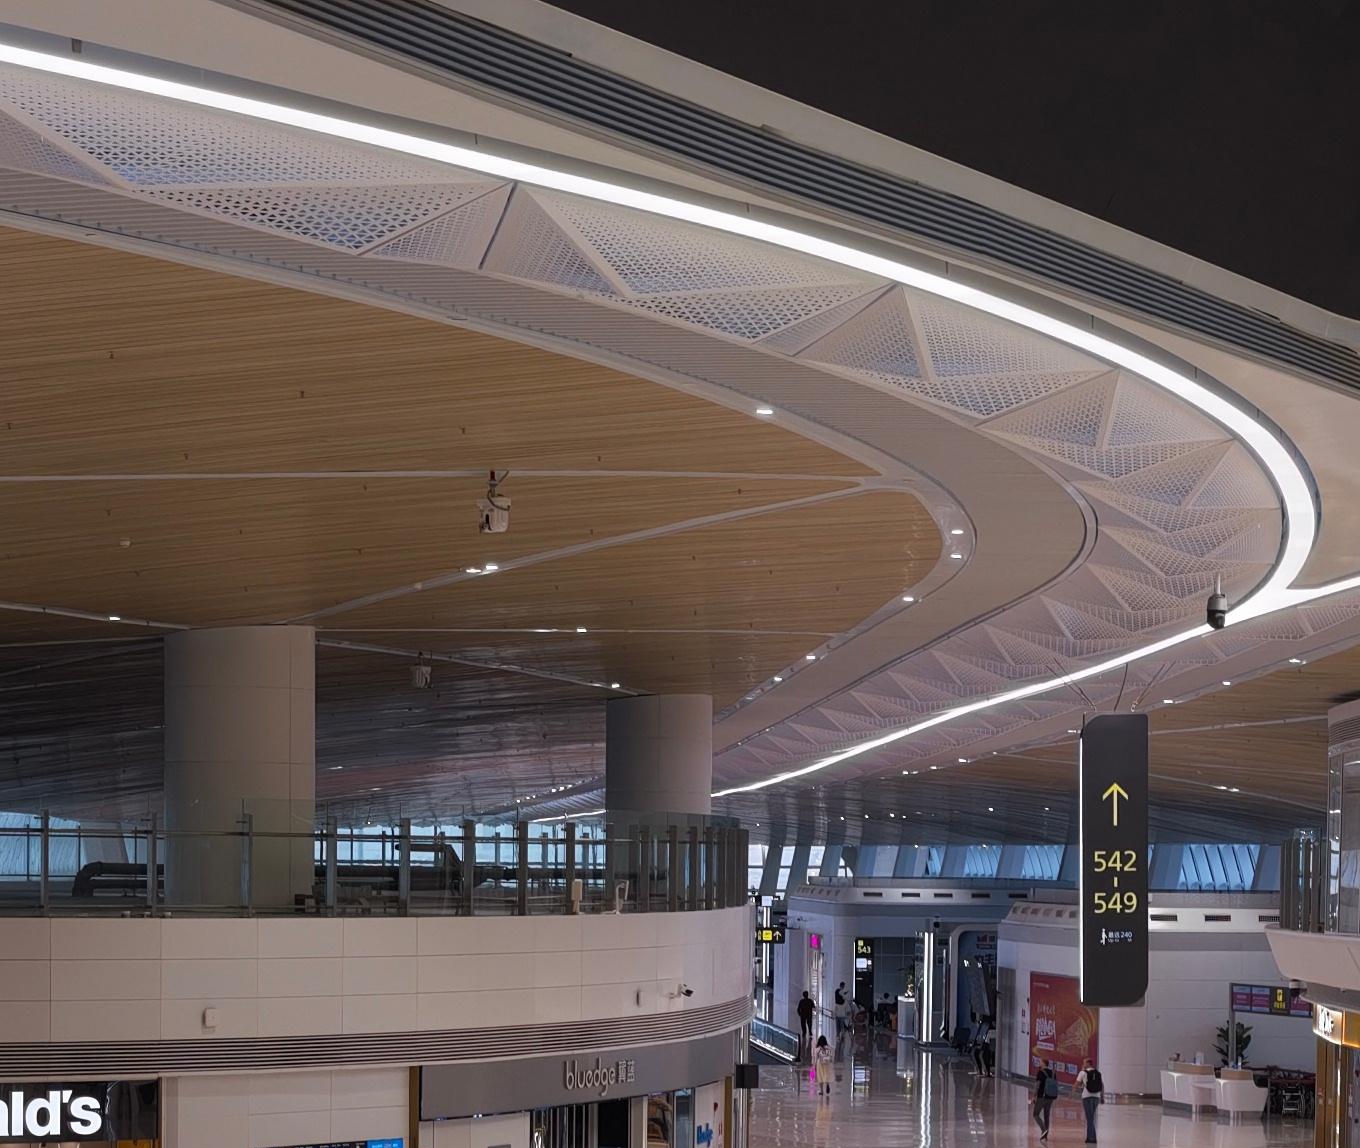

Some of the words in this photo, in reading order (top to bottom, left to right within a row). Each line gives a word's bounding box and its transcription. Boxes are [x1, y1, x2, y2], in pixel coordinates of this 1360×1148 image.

[1094, 850, 1137, 872] 542
[1094, 892, 1137, 914] 549
[857, 945, 871, 954] 543
[565, 1057, 616, 1096] bluedge
